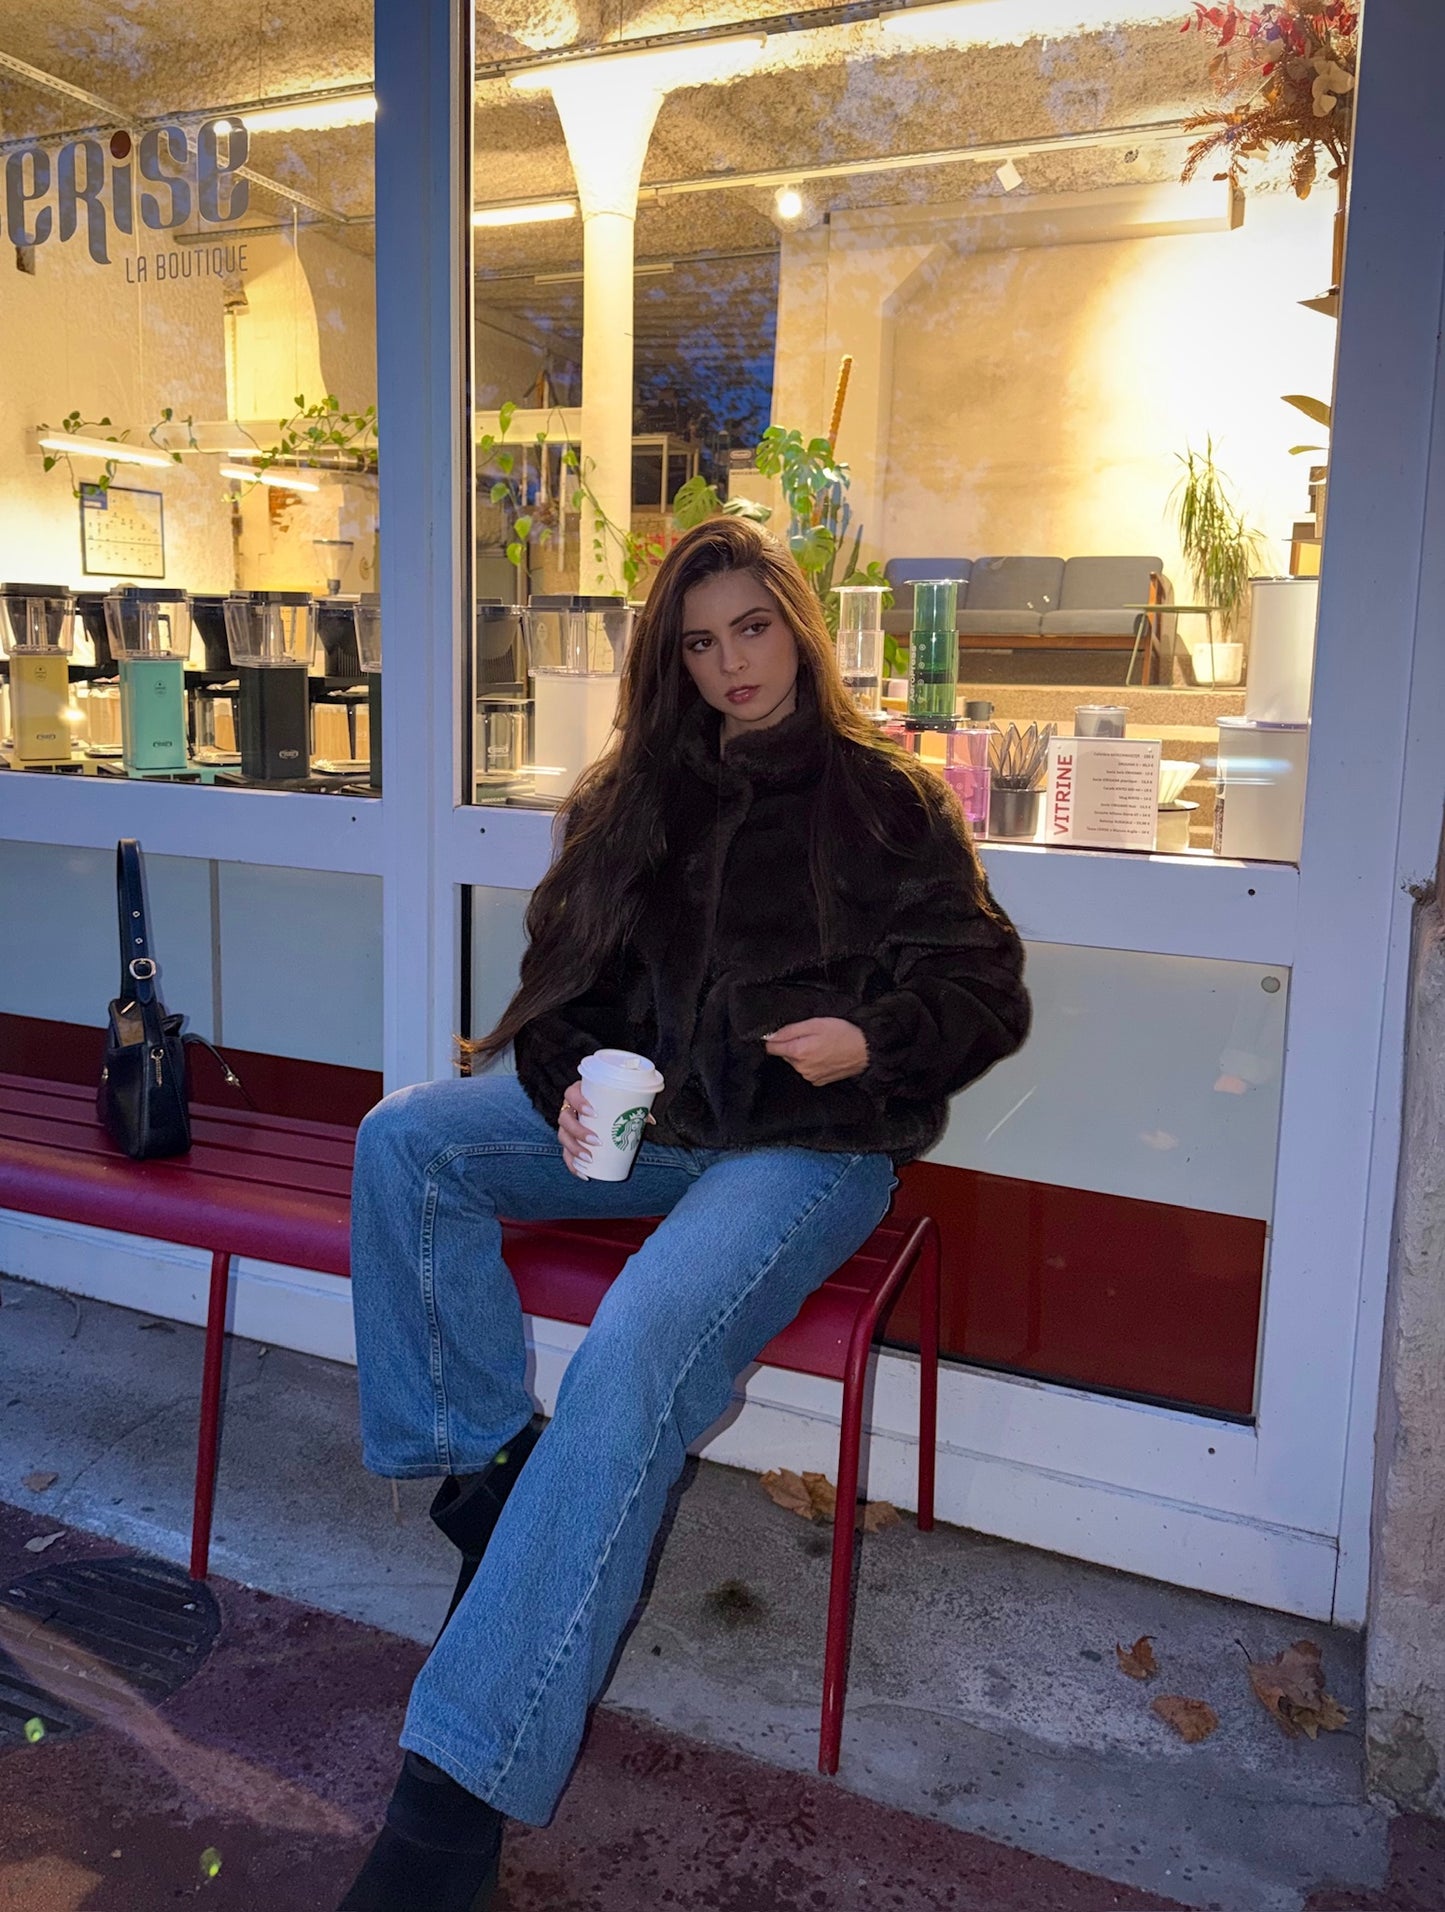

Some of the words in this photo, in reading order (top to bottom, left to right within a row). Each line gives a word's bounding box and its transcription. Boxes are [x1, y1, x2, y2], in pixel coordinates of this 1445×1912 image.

[126, 255, 147, 283] LA
[156, 244, 248, 280] BOUTIQUE
[1053, 754, 1073, 836] VITRINE
